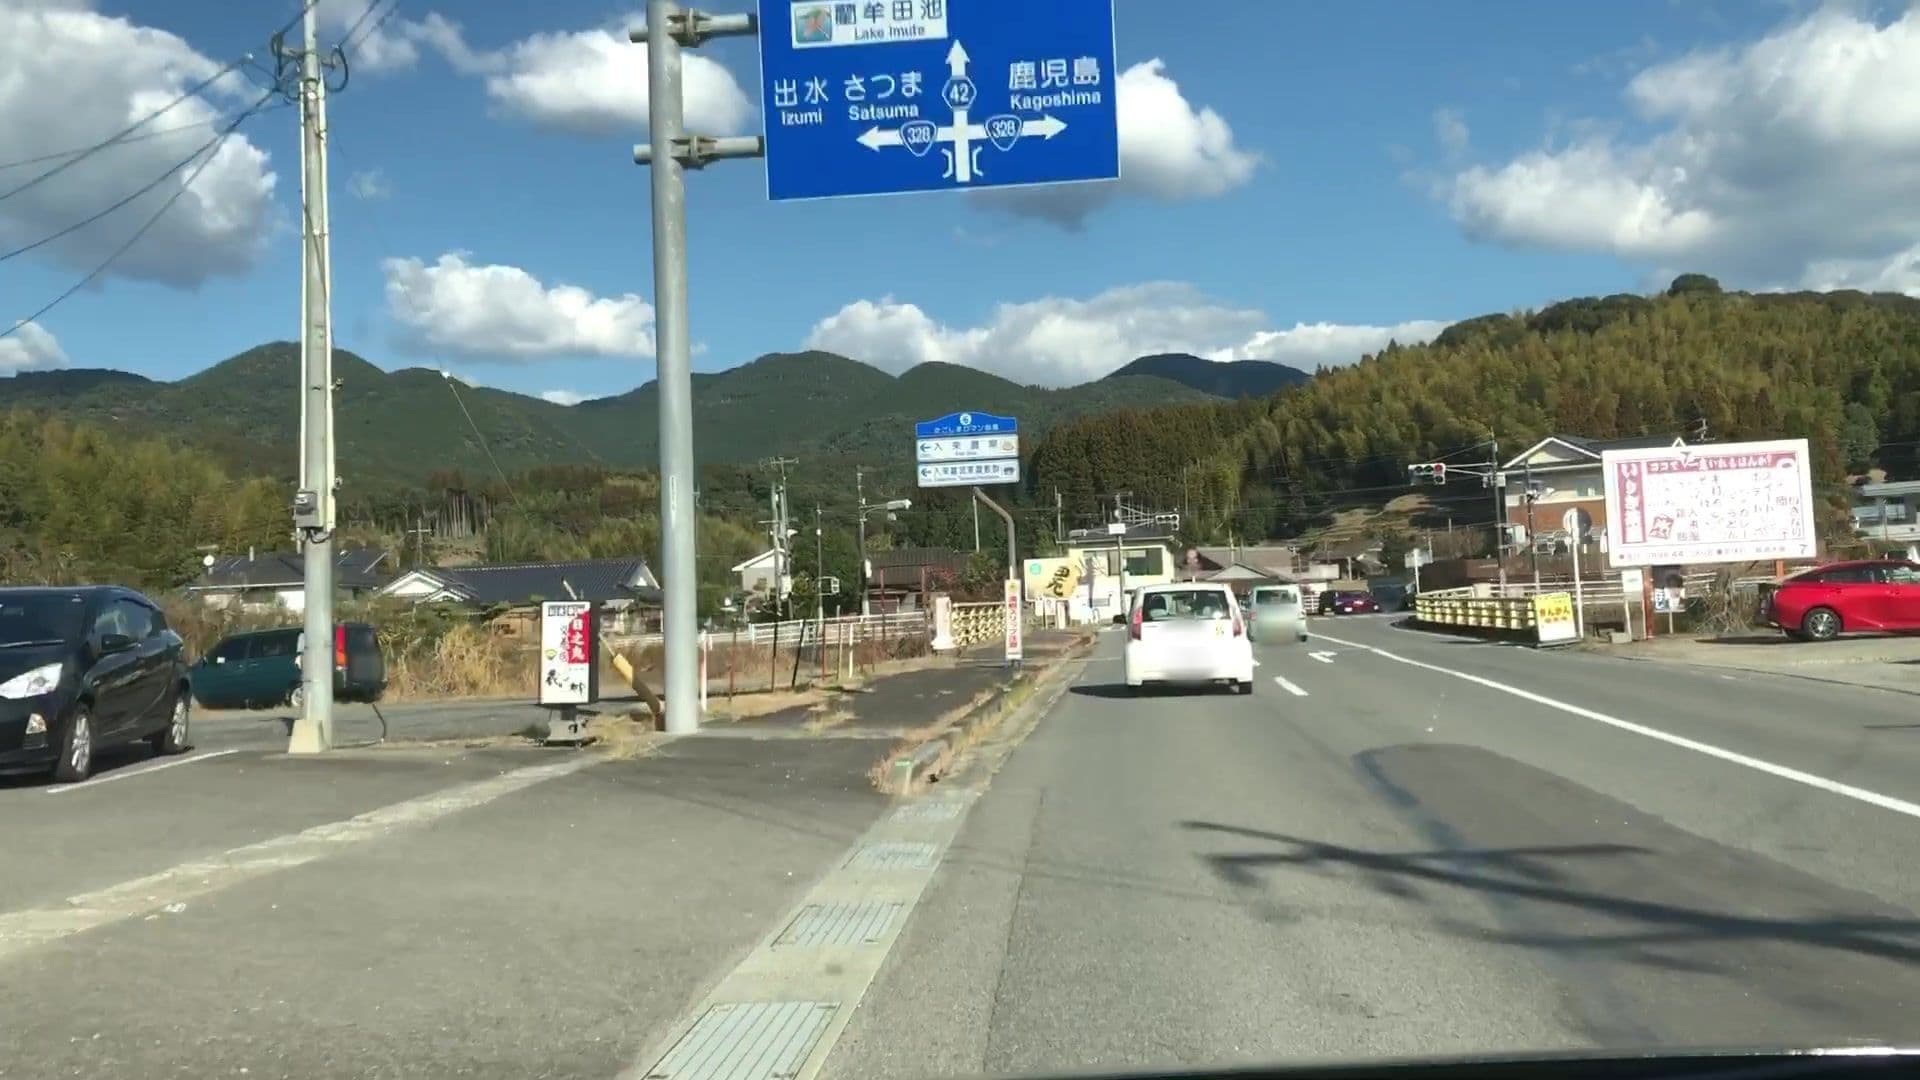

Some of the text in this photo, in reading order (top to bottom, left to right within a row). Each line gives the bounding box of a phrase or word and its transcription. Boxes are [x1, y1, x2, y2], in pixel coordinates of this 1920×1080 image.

[854, 27, 885, 40] Lake
[1008, 56, 1099, 91] 鹿児島
[774, 75, 829, 107] 出水
[844, 71, 923, 101] さつま
[949, 83, 969, 101] 42
[1010, 90, 1101, 111] Kagoshima
[781, 109, 823, 125] Izumi
[848, 104, 919, 121] Satsuma
[907, 126, 931, 143] 328
[992, 121, 1015, 138] 328
